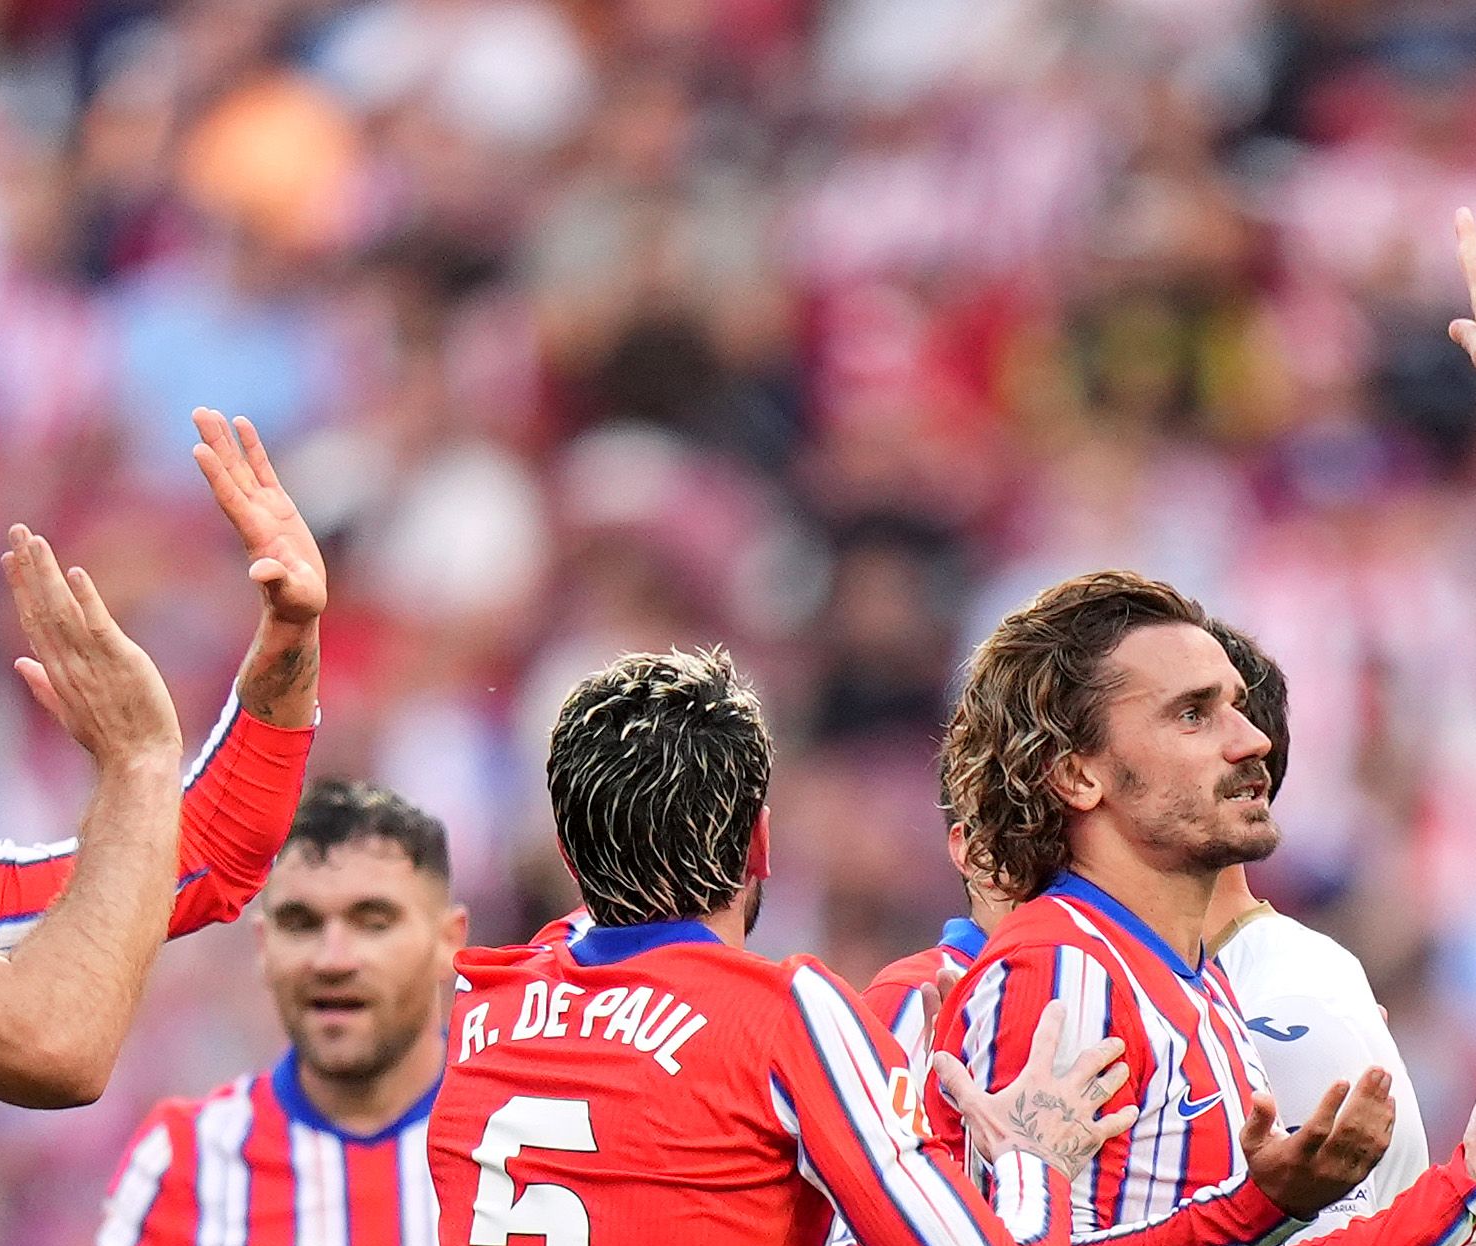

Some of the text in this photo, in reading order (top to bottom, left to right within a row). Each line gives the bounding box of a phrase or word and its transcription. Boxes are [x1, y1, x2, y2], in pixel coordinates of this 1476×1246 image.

[458, 980, 708, 1076] R. DE PAUL
